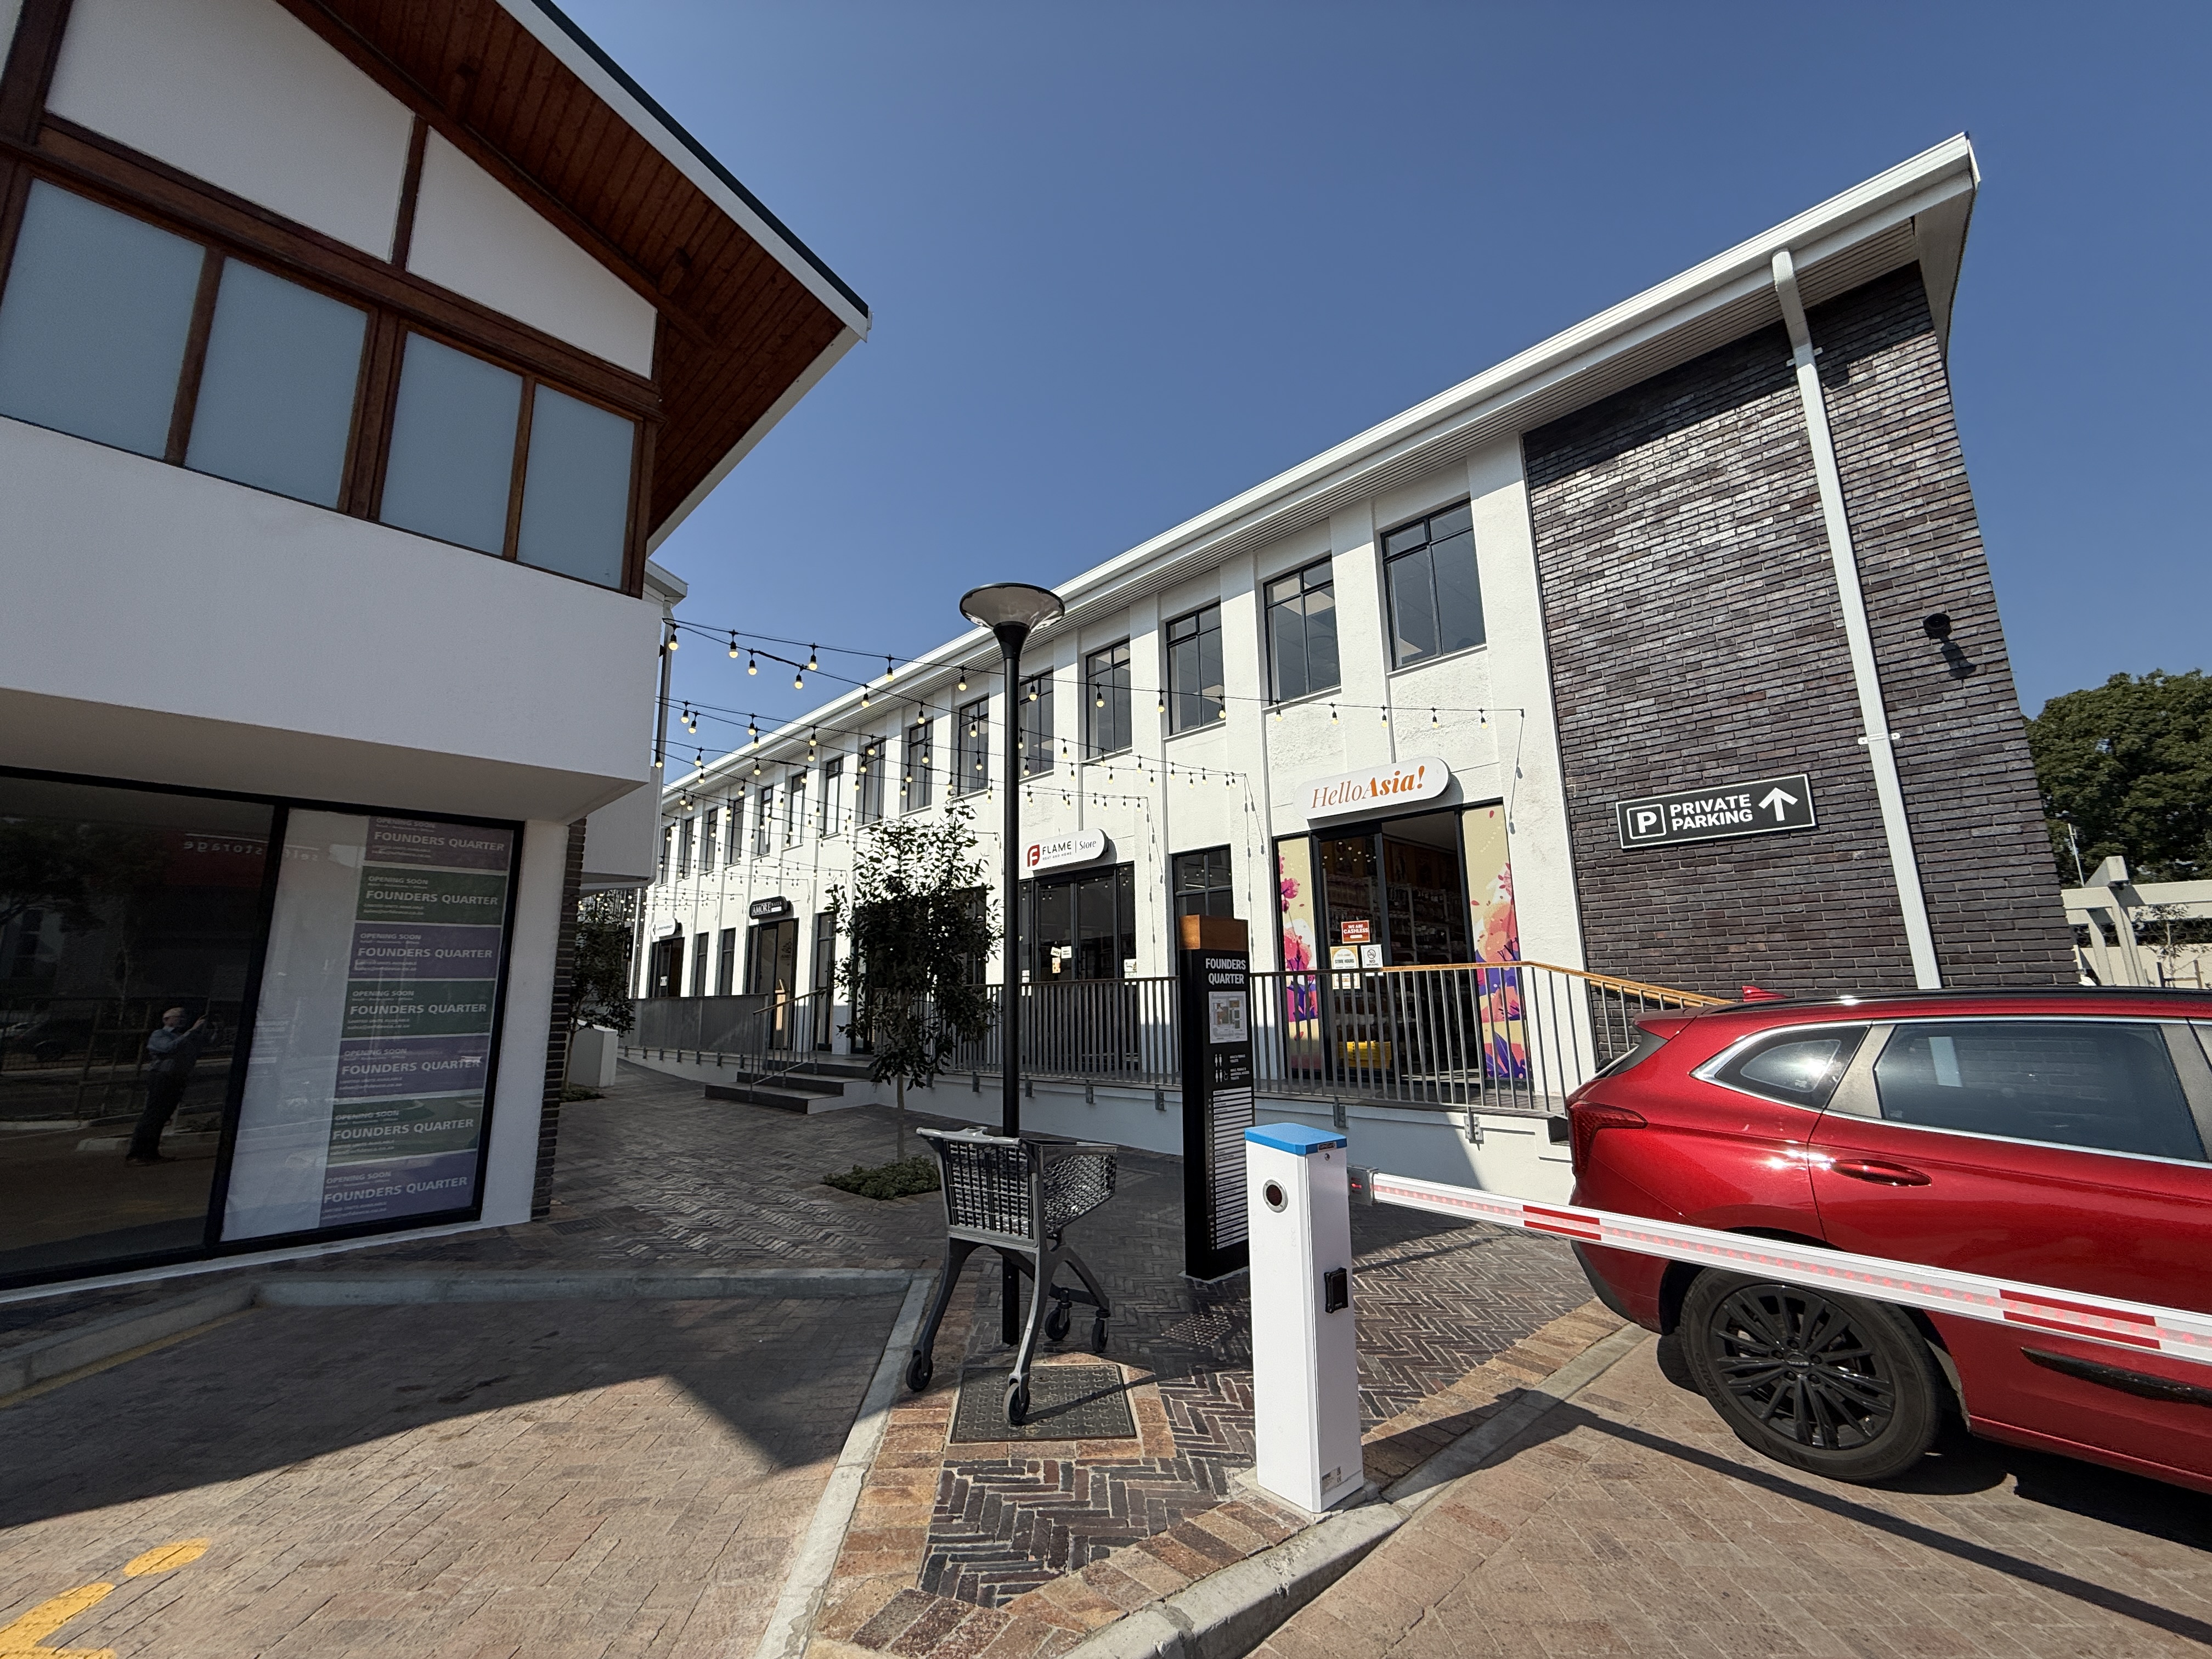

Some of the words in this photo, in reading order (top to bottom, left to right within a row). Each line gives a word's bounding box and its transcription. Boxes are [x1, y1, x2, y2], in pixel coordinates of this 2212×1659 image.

[1669, 793, 1752, 817] PRIVATE
[1637, 811, 1657, 833] P
[1672, 809, 1753, 831] PARKING
[374, 831, 444, 846] FOUNDERS
[449, 838, 504, 851] QUARTER
[1042, 840, 1072, 855] FLAME
[1079, 840, 1097, 850] Store
[365, 890, 438, 902] FOUNDERS
[442, 894, 498, 905] QUARTER
[753, 903, 771, 914] AMORE
[358, 947, 430, 957] FOUNDERS
[435, 949, 493, 959] QUARTER
[1205, 958, 1246, 970] FOUNDERS
[1208, 973, 1244, 985] QUARTER
[350, 1005, 424, 1015] FOUNDERS
[428, 1003, 487, 1014] QUARTER
[342, 1062, 417, 1075] FOUNDERS
[332, 1124, 409, 1141] FOUNDERS
[414, 1119, 473, 1133] QUARTER
[326, 1173, 365, 1184] OPENING
[367, 1170, 392, 1178] SOON
[324, 1186, 402, 1204] FOUNDERS
[406, 1177, 468, 1193] QUARTER
